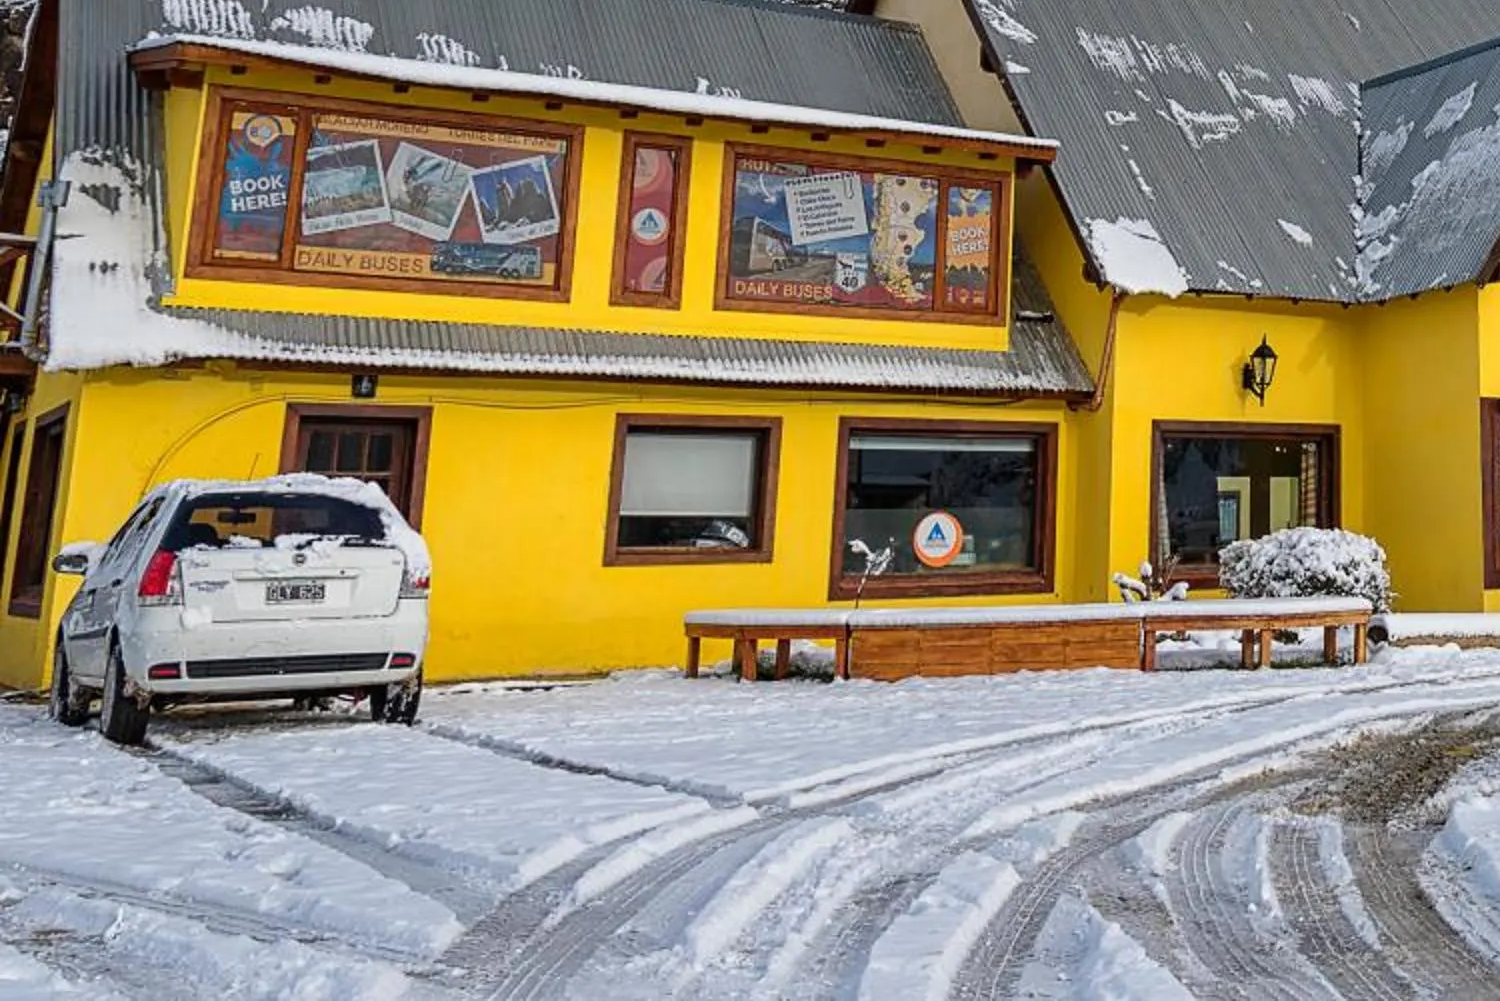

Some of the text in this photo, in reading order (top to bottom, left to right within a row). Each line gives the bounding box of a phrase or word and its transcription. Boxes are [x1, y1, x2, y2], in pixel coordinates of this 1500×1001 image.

[229, 174, 285, 195] BOOK
[231, 191, 287, 212] HERE!
[298, 251, 424, 273] DAILY BUSES
[735, 280, 833, 298] DAILY BUSES
[841, 276, 859, 288] 40
